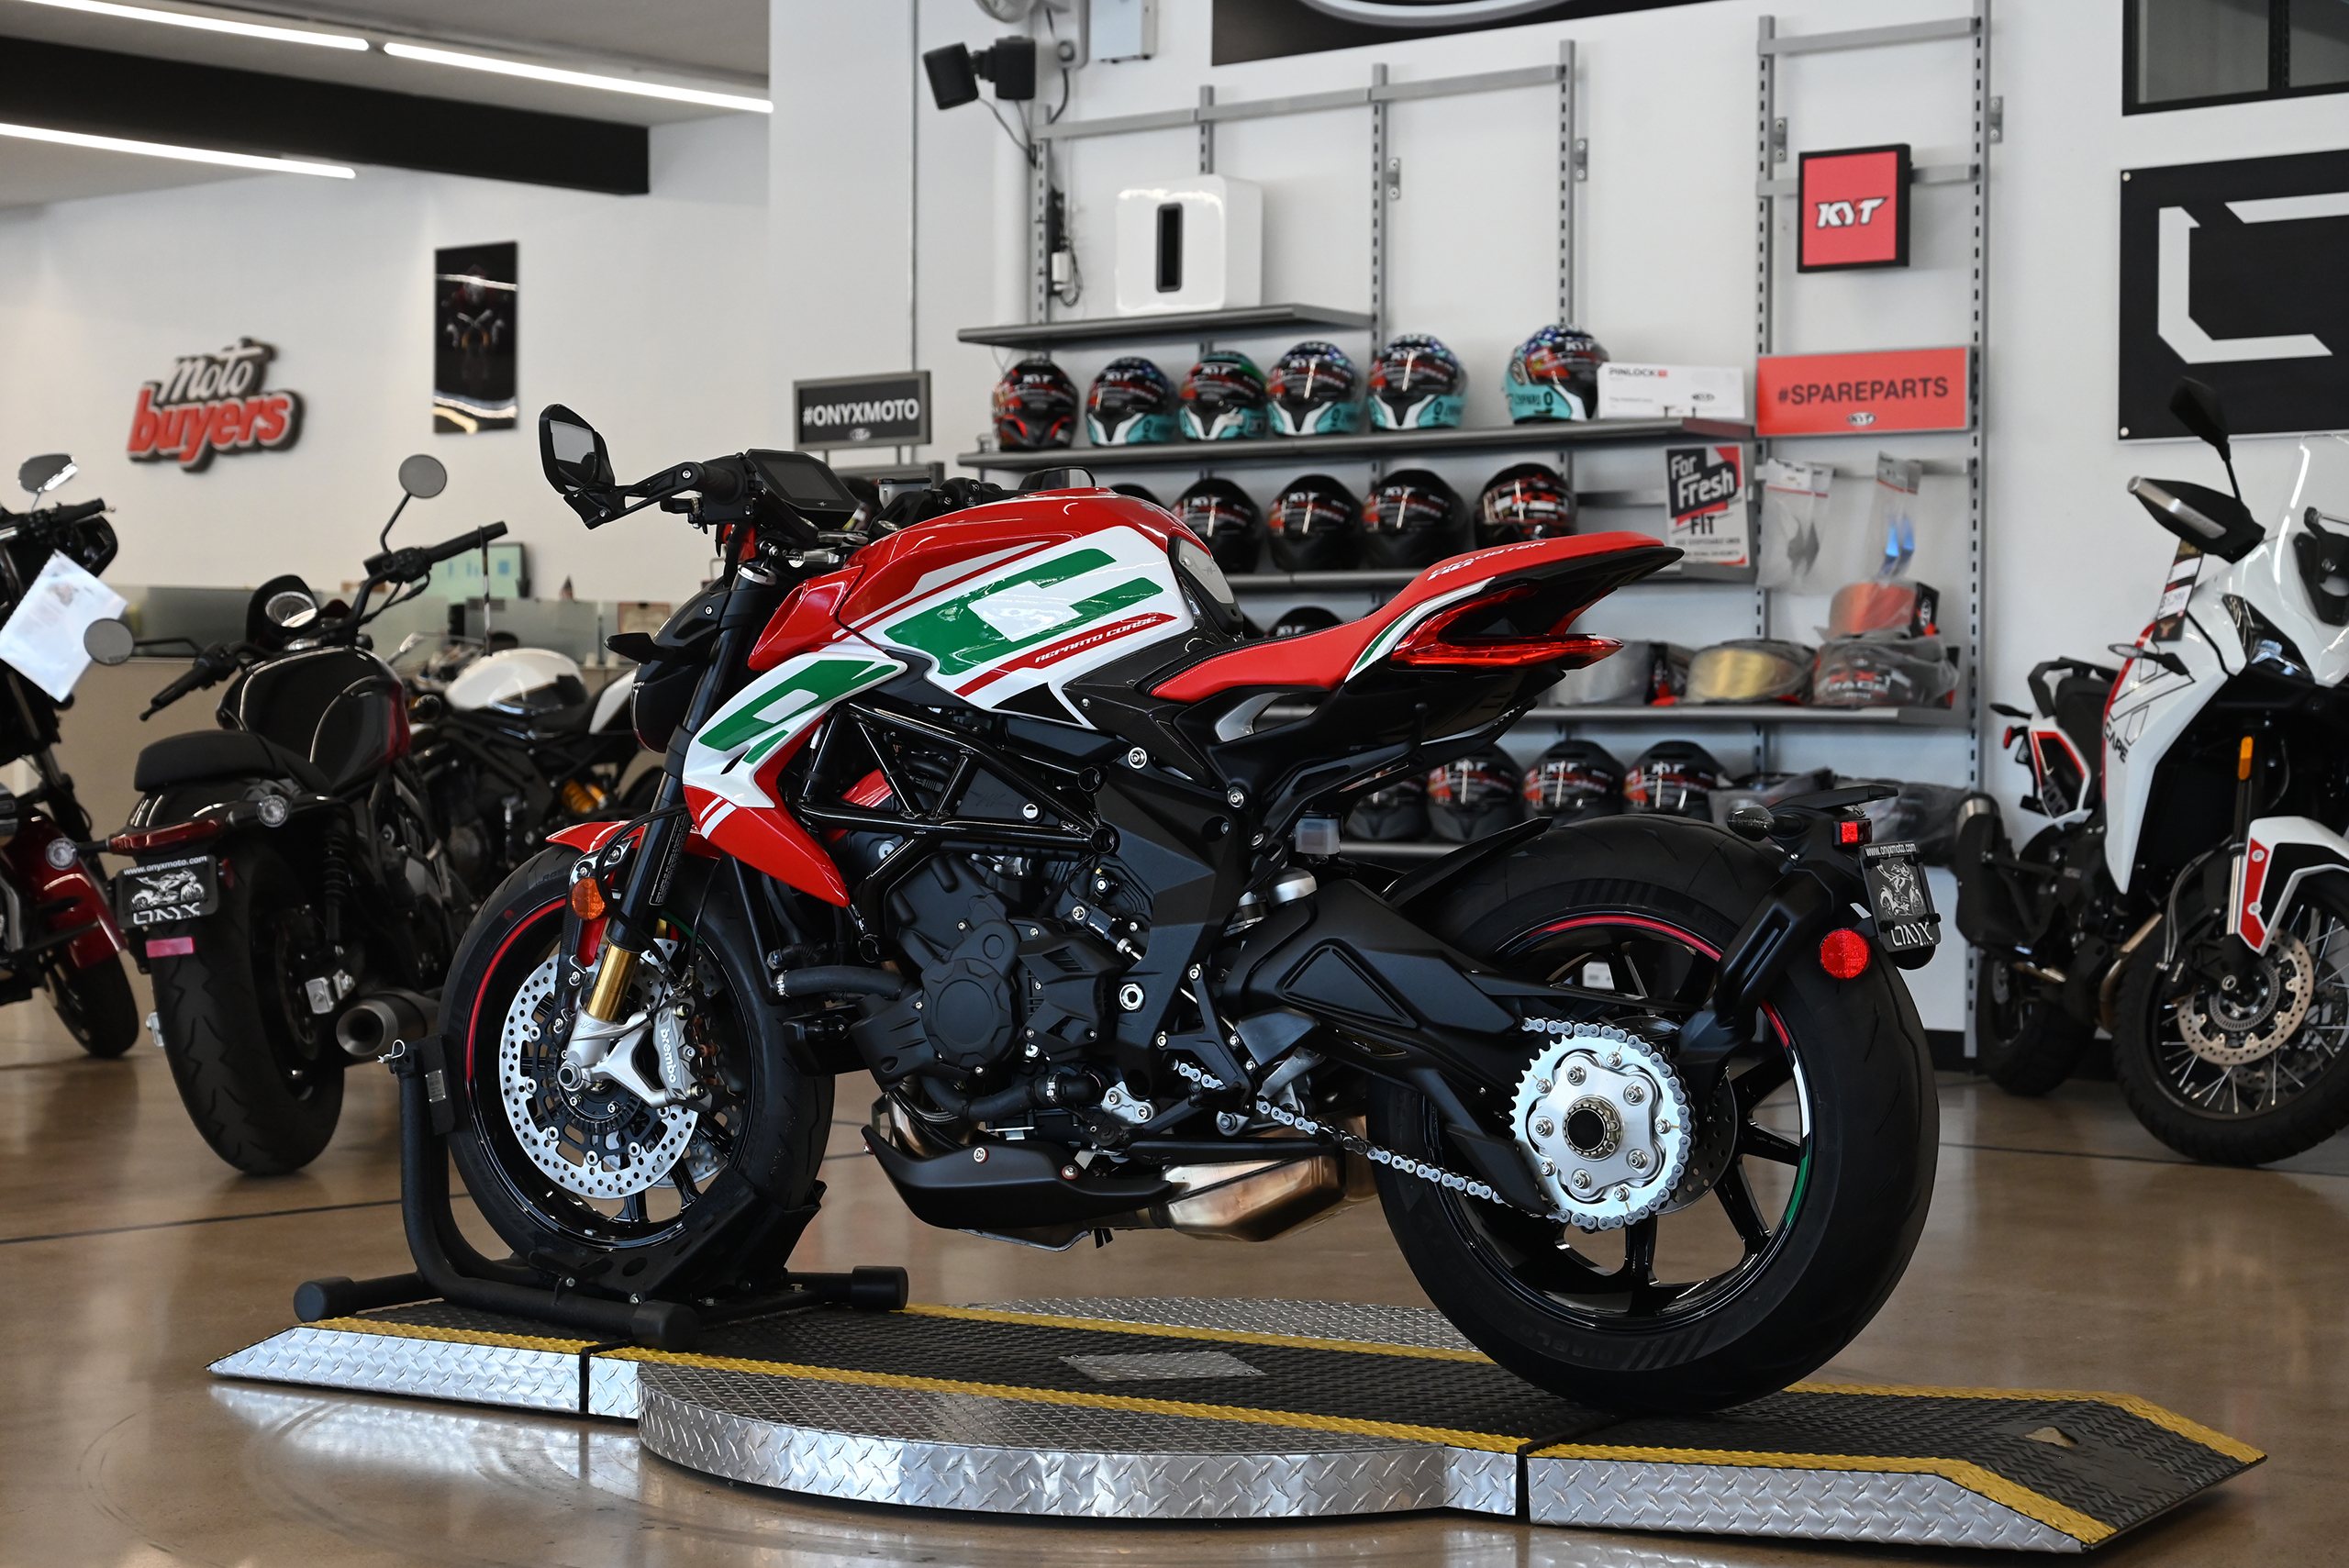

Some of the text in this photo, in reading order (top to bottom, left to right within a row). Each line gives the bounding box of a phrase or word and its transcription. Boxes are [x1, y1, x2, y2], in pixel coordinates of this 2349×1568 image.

[1816, 197, 1888, 228] KYT
[1778, 376, 1949, 406] #SPAREPARTS
[128, 386, 293, 463] buyers
[803, 398, 920, 427] #ONYXMOTO
[1670, 453, 1698, 480] For
[1677, 468, 1735, 509] Fresh
[1690, 514, 1716, 536] FIT
[1035, 616, 1157, 663] REPARTO CORSE
[123, 855, 208, 875] www.onyxmoto.com
[1865, 843, 1917, 858] www.onyxmoto.com
[133, 902, 201, 925] ONYX
[1890, 921, 1933, 947] ONYX
[661, 1029, 677, 1084] brembo
